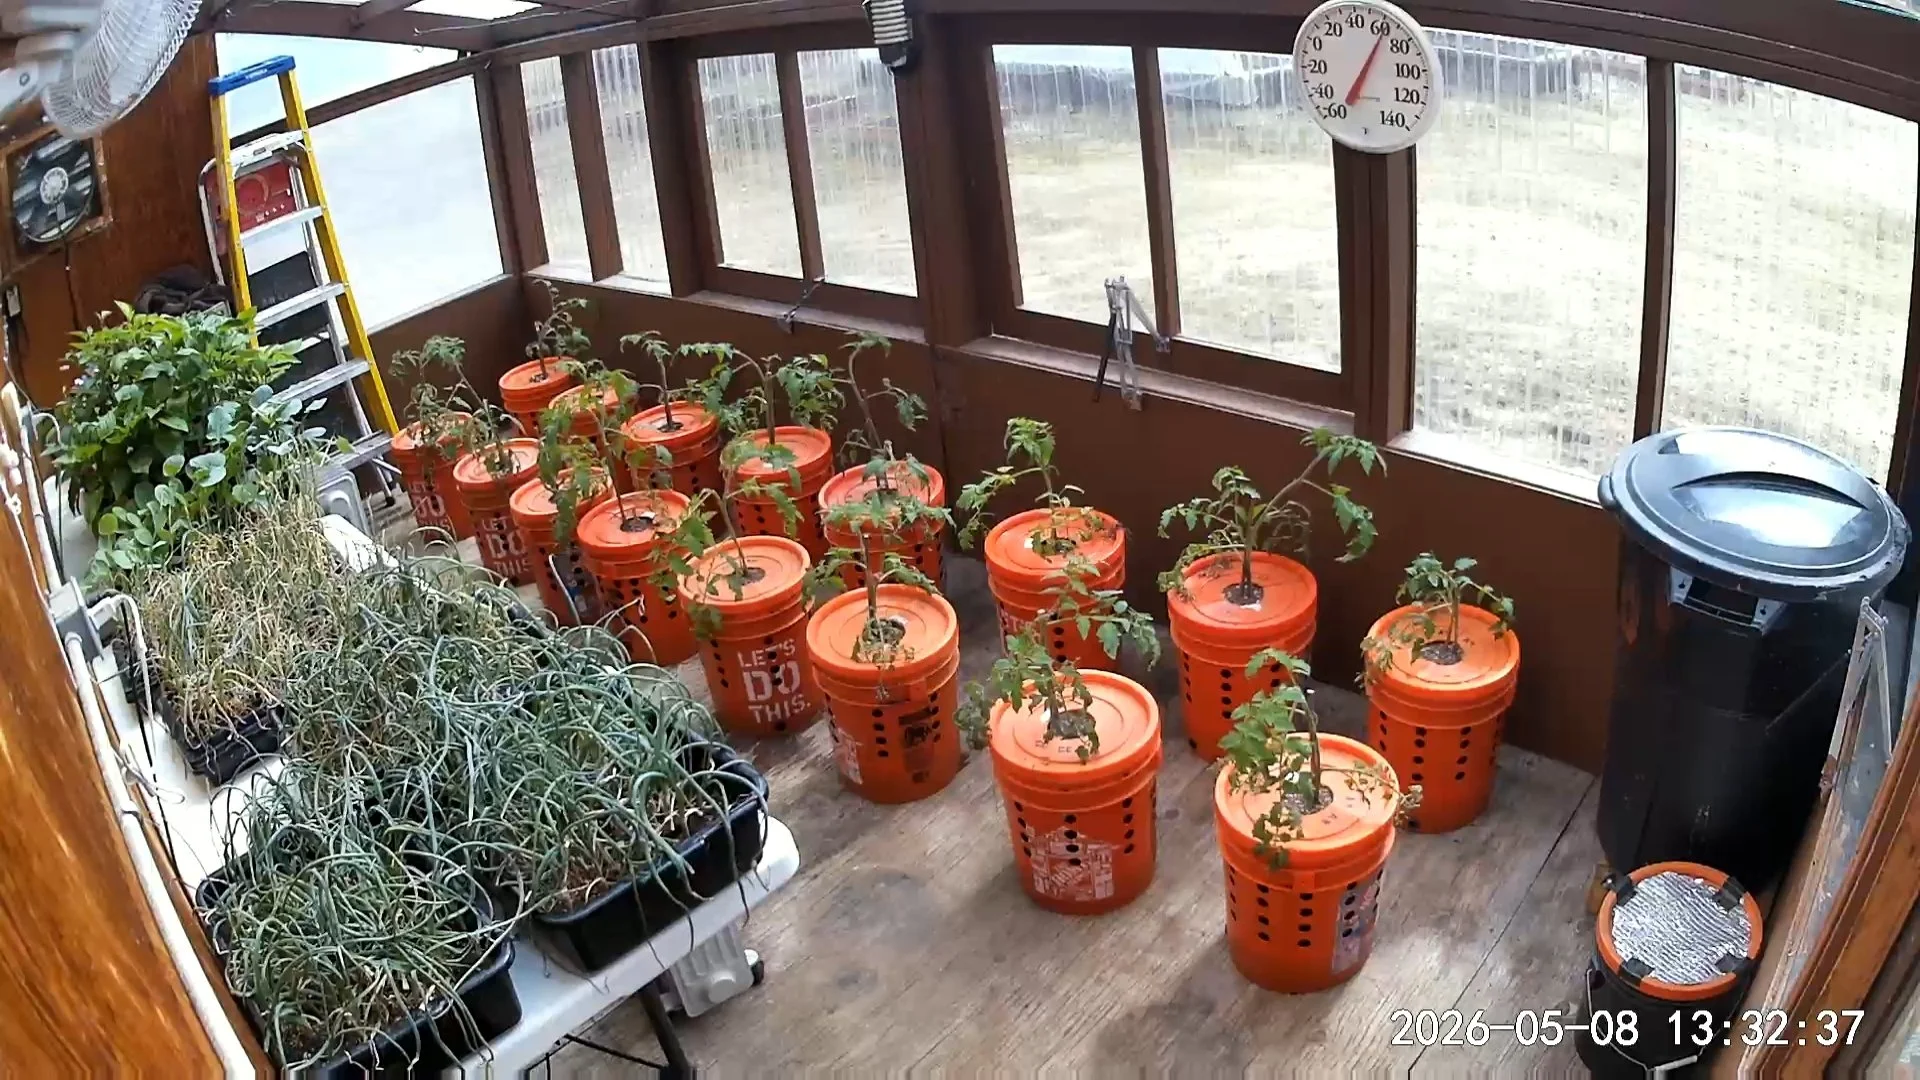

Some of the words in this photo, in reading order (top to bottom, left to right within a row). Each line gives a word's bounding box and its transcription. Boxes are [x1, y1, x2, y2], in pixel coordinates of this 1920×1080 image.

[1324, 21, 1343, 37] 20
[1345, 13, 1365, 29] 40
[1370, 20, 1391, 37] 60
[1312, 36, 1323, 51] 0
[1390, 39, 1410, 55] 80
[1308, 59, 1328, 75] -20
[1395, 63, 1421, 80] 100
[1312, 83, 1334, 99] -40
[1394, 87, 1421, 105] 120
[1323, 103, 1347, 119] -60
[1380, 110, 1406, 128] 140
[742, 660, 801, 702] DO
[748, 694, 812, 724] THIS.
